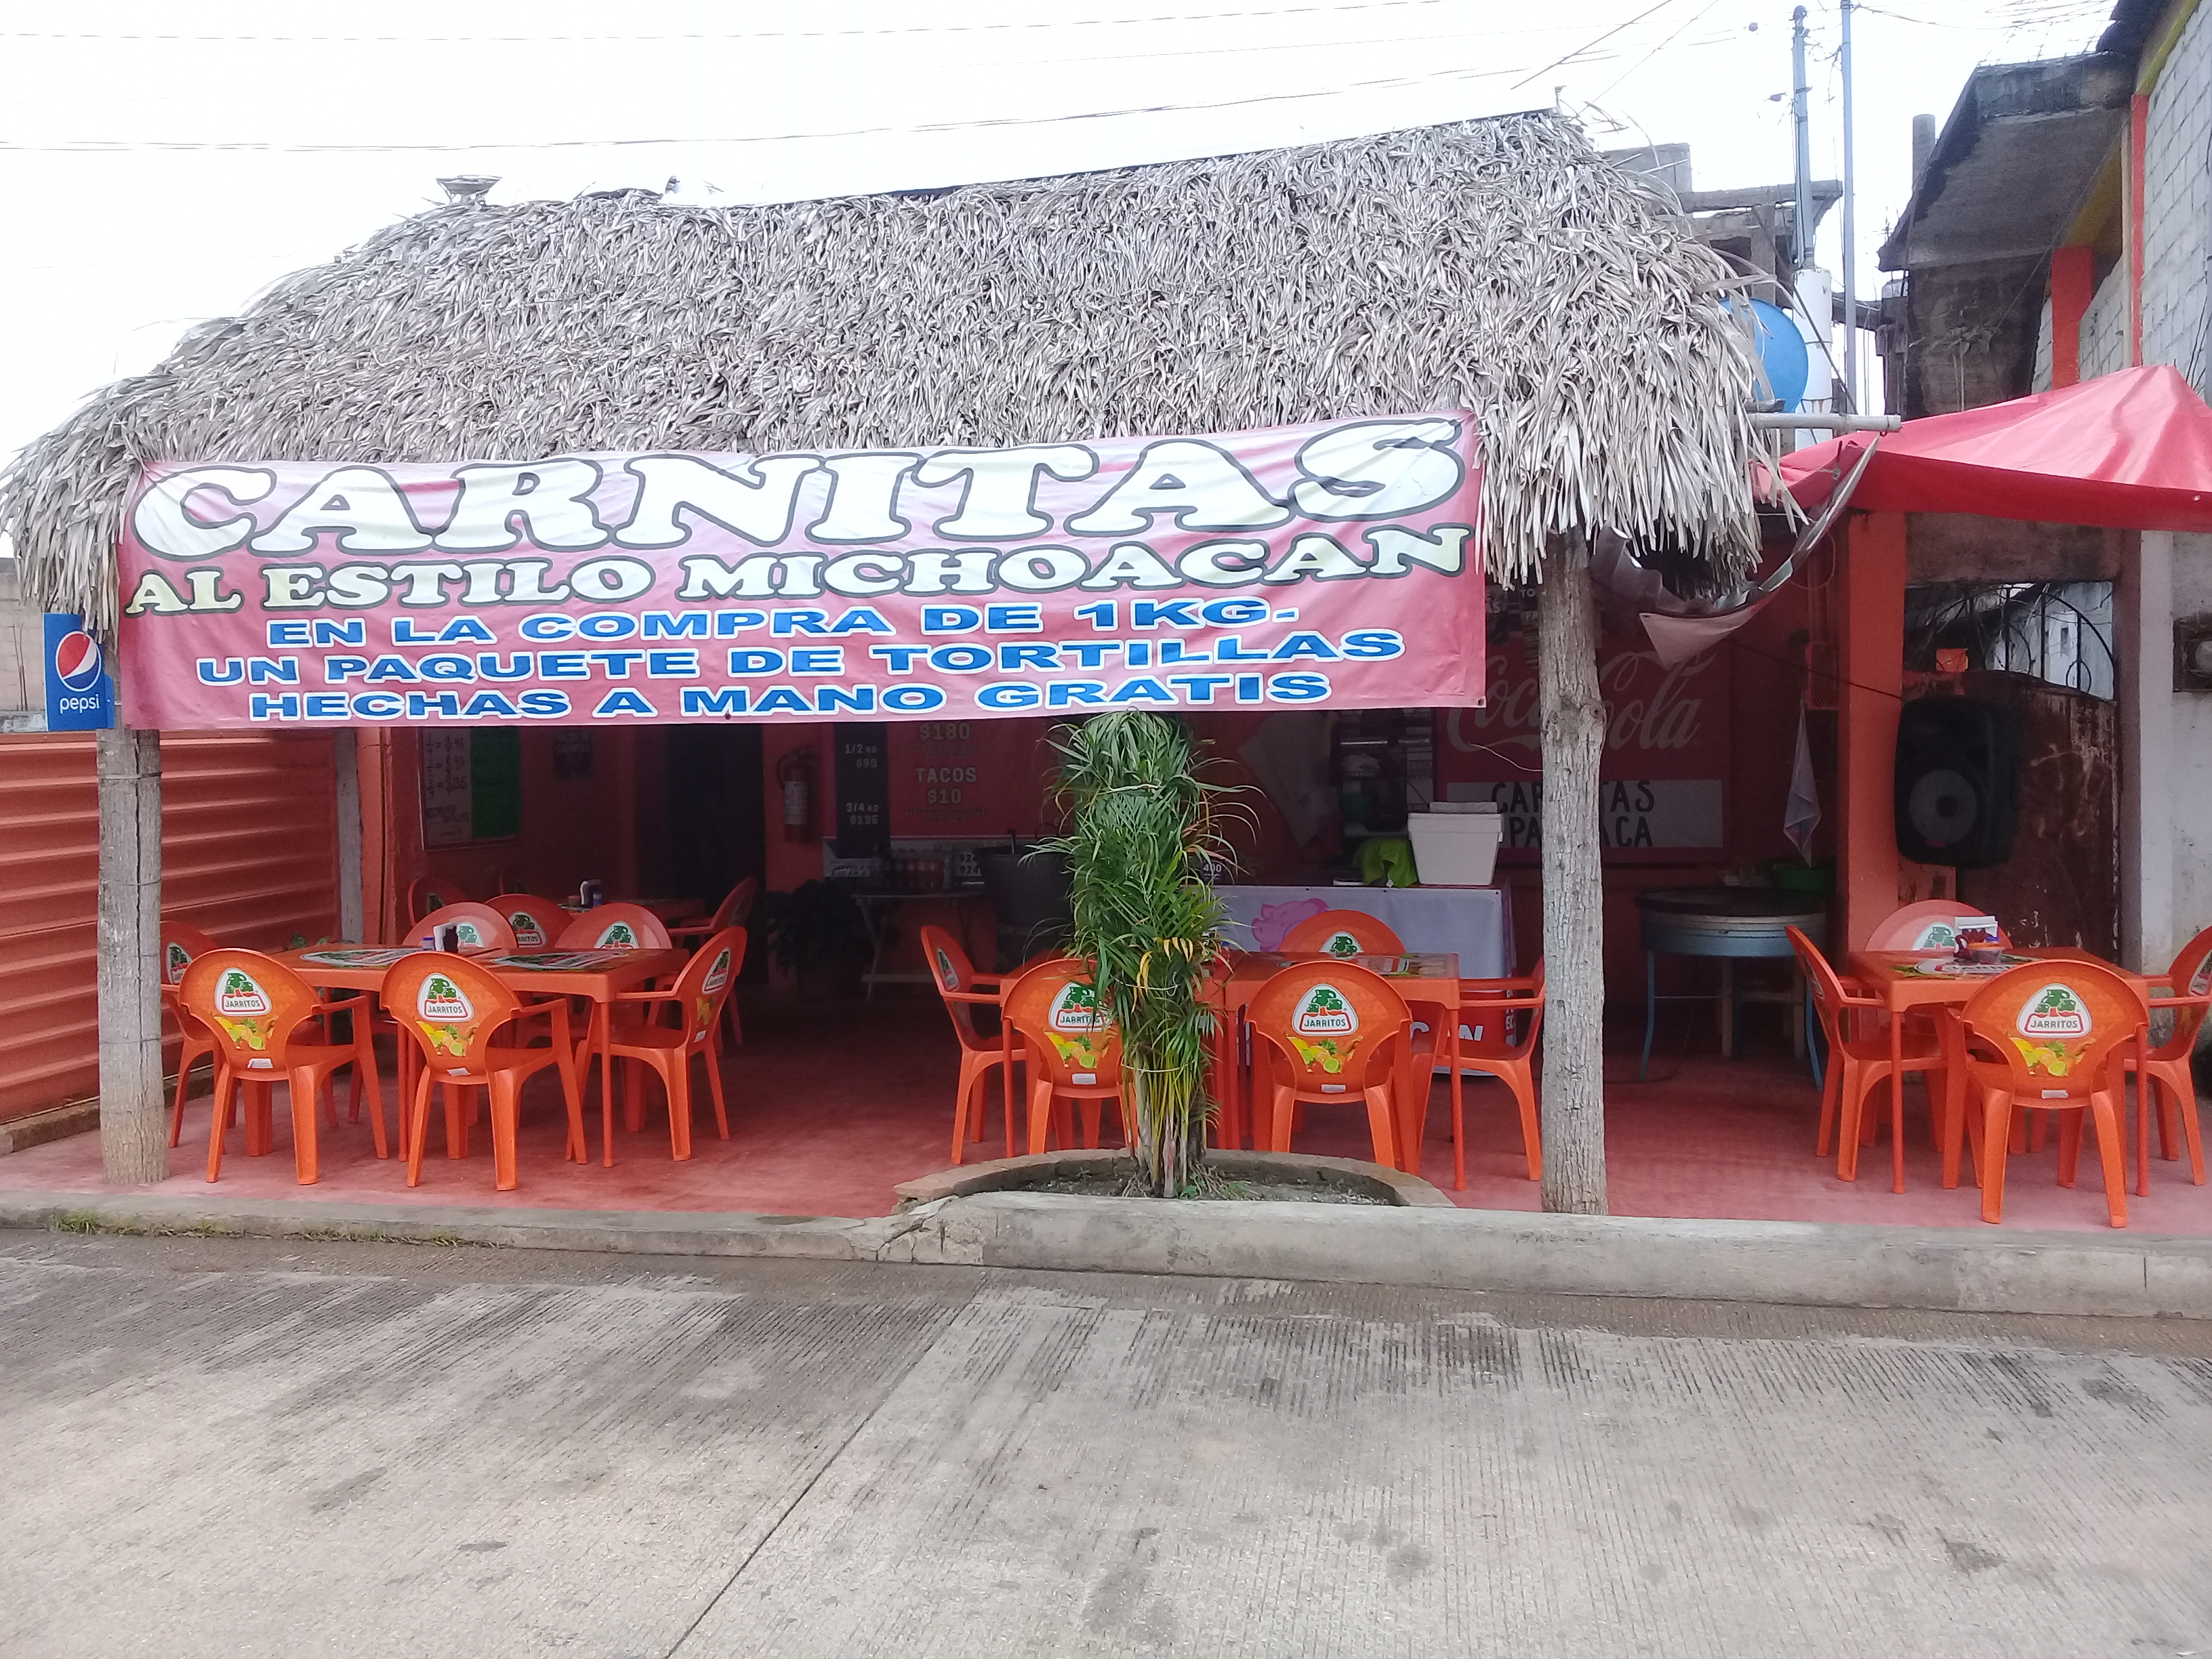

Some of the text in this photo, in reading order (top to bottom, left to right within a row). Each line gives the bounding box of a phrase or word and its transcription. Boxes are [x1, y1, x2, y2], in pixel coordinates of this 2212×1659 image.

[135, 418, 1465, 561] CARNITAS
[124, 567, 243, 617] AL
[261, 556, 656, 611] ESTILO
[676, 524, 1473, 602] MICHOACAN
[267, 617, 366, 650] EN
[392, 615, 497, 648] LA
[520, 607, 895, 643] COMPRA
[920, 602, 1044, 635] DE
[196, 630, 1405, 687] UN PAQUETE DE TORTILLAS
[60, 693, 100, 714] pepsi
[249, 672, 1332, 721] HECHAS A MANO GRATIS
[920, 722, 970, 741] $180
[844, 743, 878, 754] 1/2 KG
[856, 758, 878, 769] $90
[916, 766, 977, 783] TACOS
[927, 787, 962, 805] $10
[846, 802, 879, 813] 3/4 KG
[225, 999, 261, 1008] JARRITOS
[428, 1005, 463, 1014] JARRITOS
[1304, 1018, 1347, 1027] JARRITOS
[2030, 1020, 2078, 1029] JARRITOS
